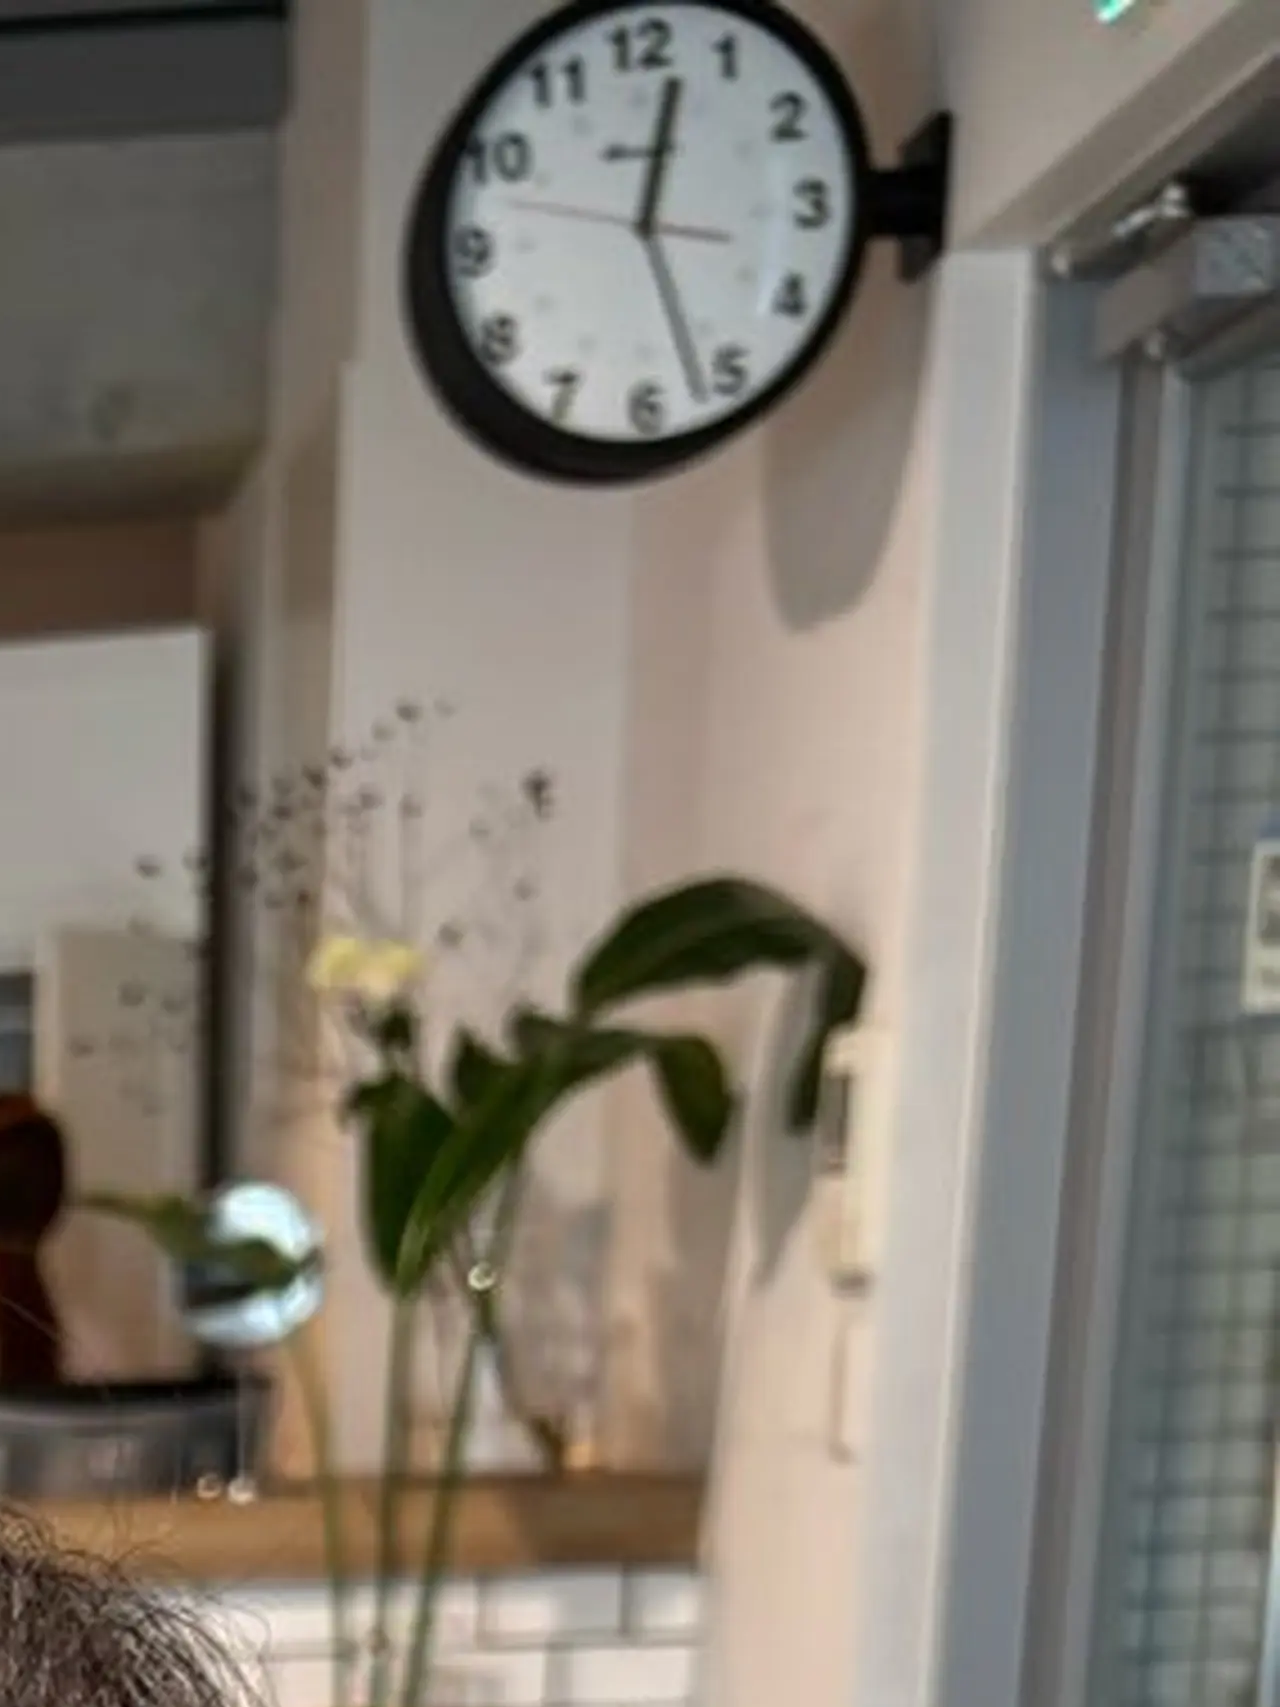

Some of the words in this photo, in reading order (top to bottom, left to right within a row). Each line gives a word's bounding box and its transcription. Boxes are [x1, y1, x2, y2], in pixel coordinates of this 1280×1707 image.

[606, 19, 674, 71] 12
[712, 34, 739, 80] 1
[532, 58, 587, 107] 11
[770, 93, 809, 142] 2
[462, 133, 532, 183] 10
[793, 178, 830, 229] 3
[454, 226, 493, 277] 9
[773, 274, 808, 318] 4
[479, 316, 518, 365] 8
[712, 346, 748, 395] 5
[545, 369, 584, 425] 7
[628, 380, 665, 435] 6
